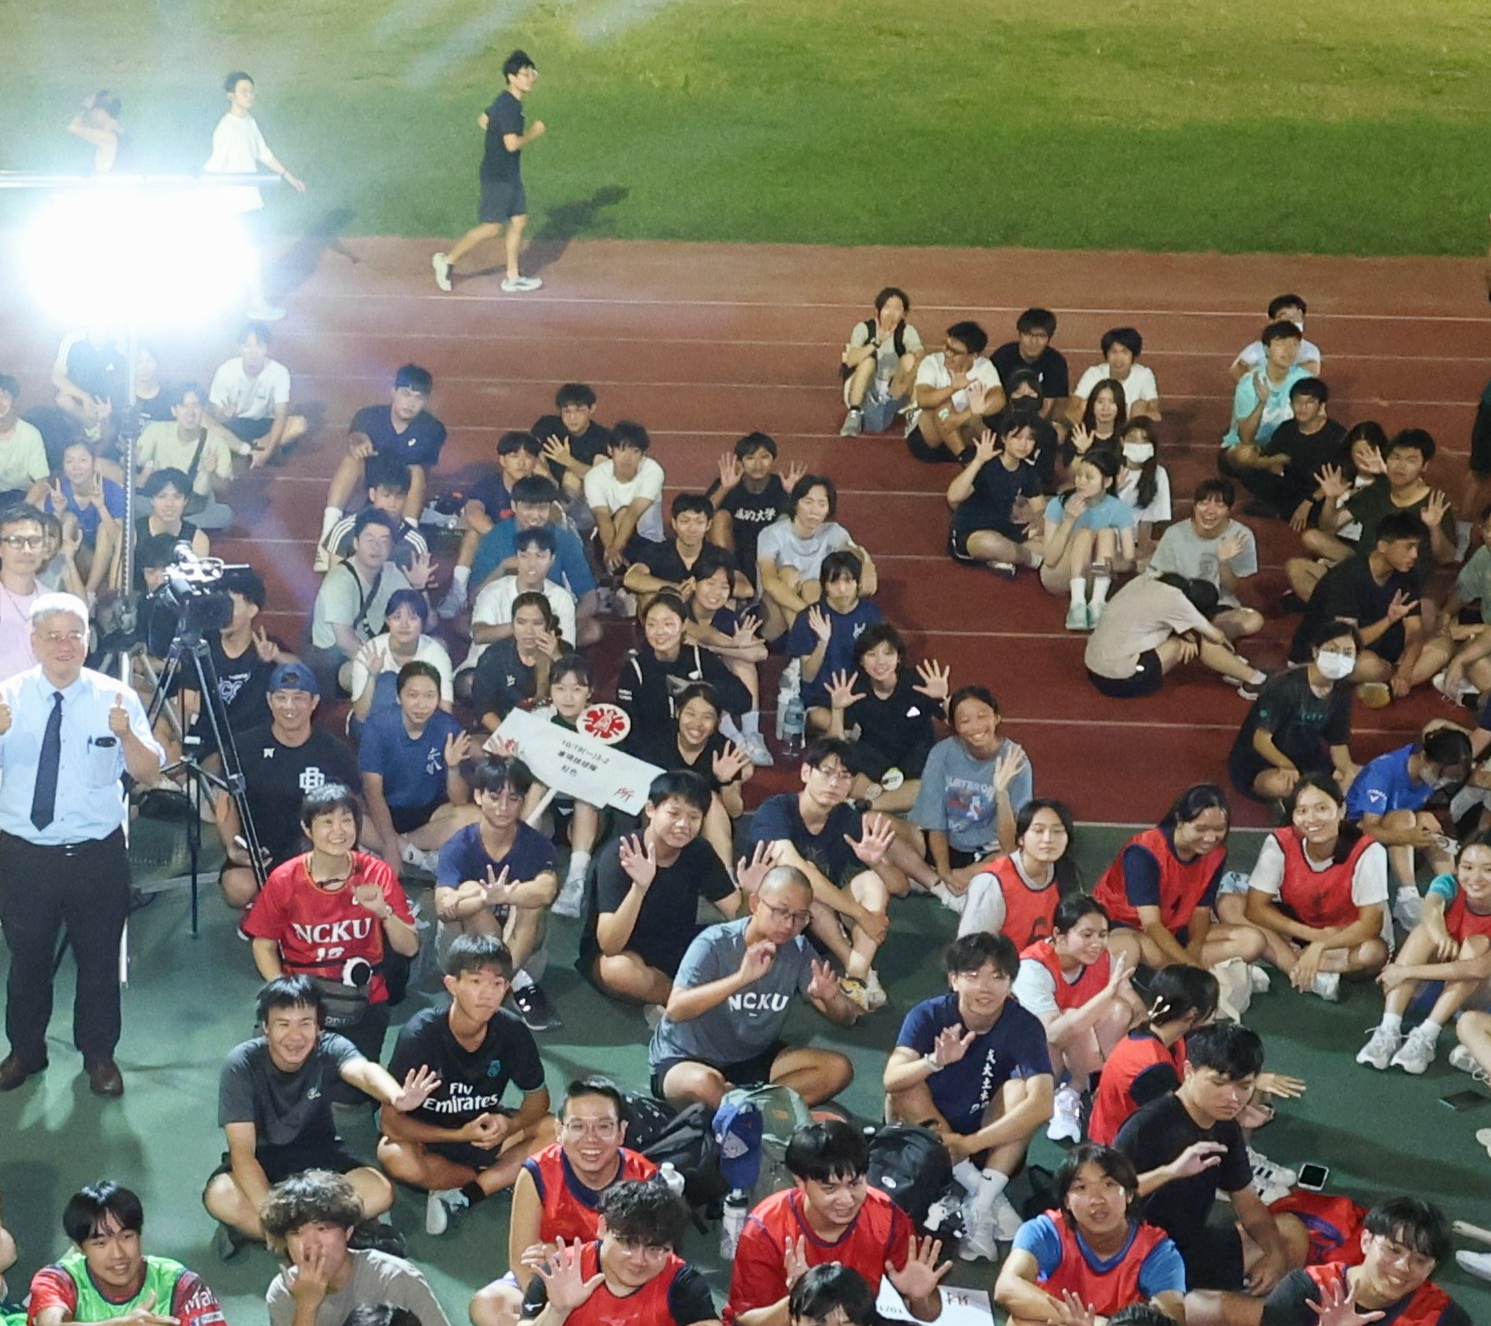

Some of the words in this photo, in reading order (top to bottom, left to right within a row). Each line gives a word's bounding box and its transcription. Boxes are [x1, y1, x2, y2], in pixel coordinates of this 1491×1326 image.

[293, 918, 371, 945] NCKU
[728, 992, 789, 1012] NCKU
[423, 1094, 498, 1113] Emirates
